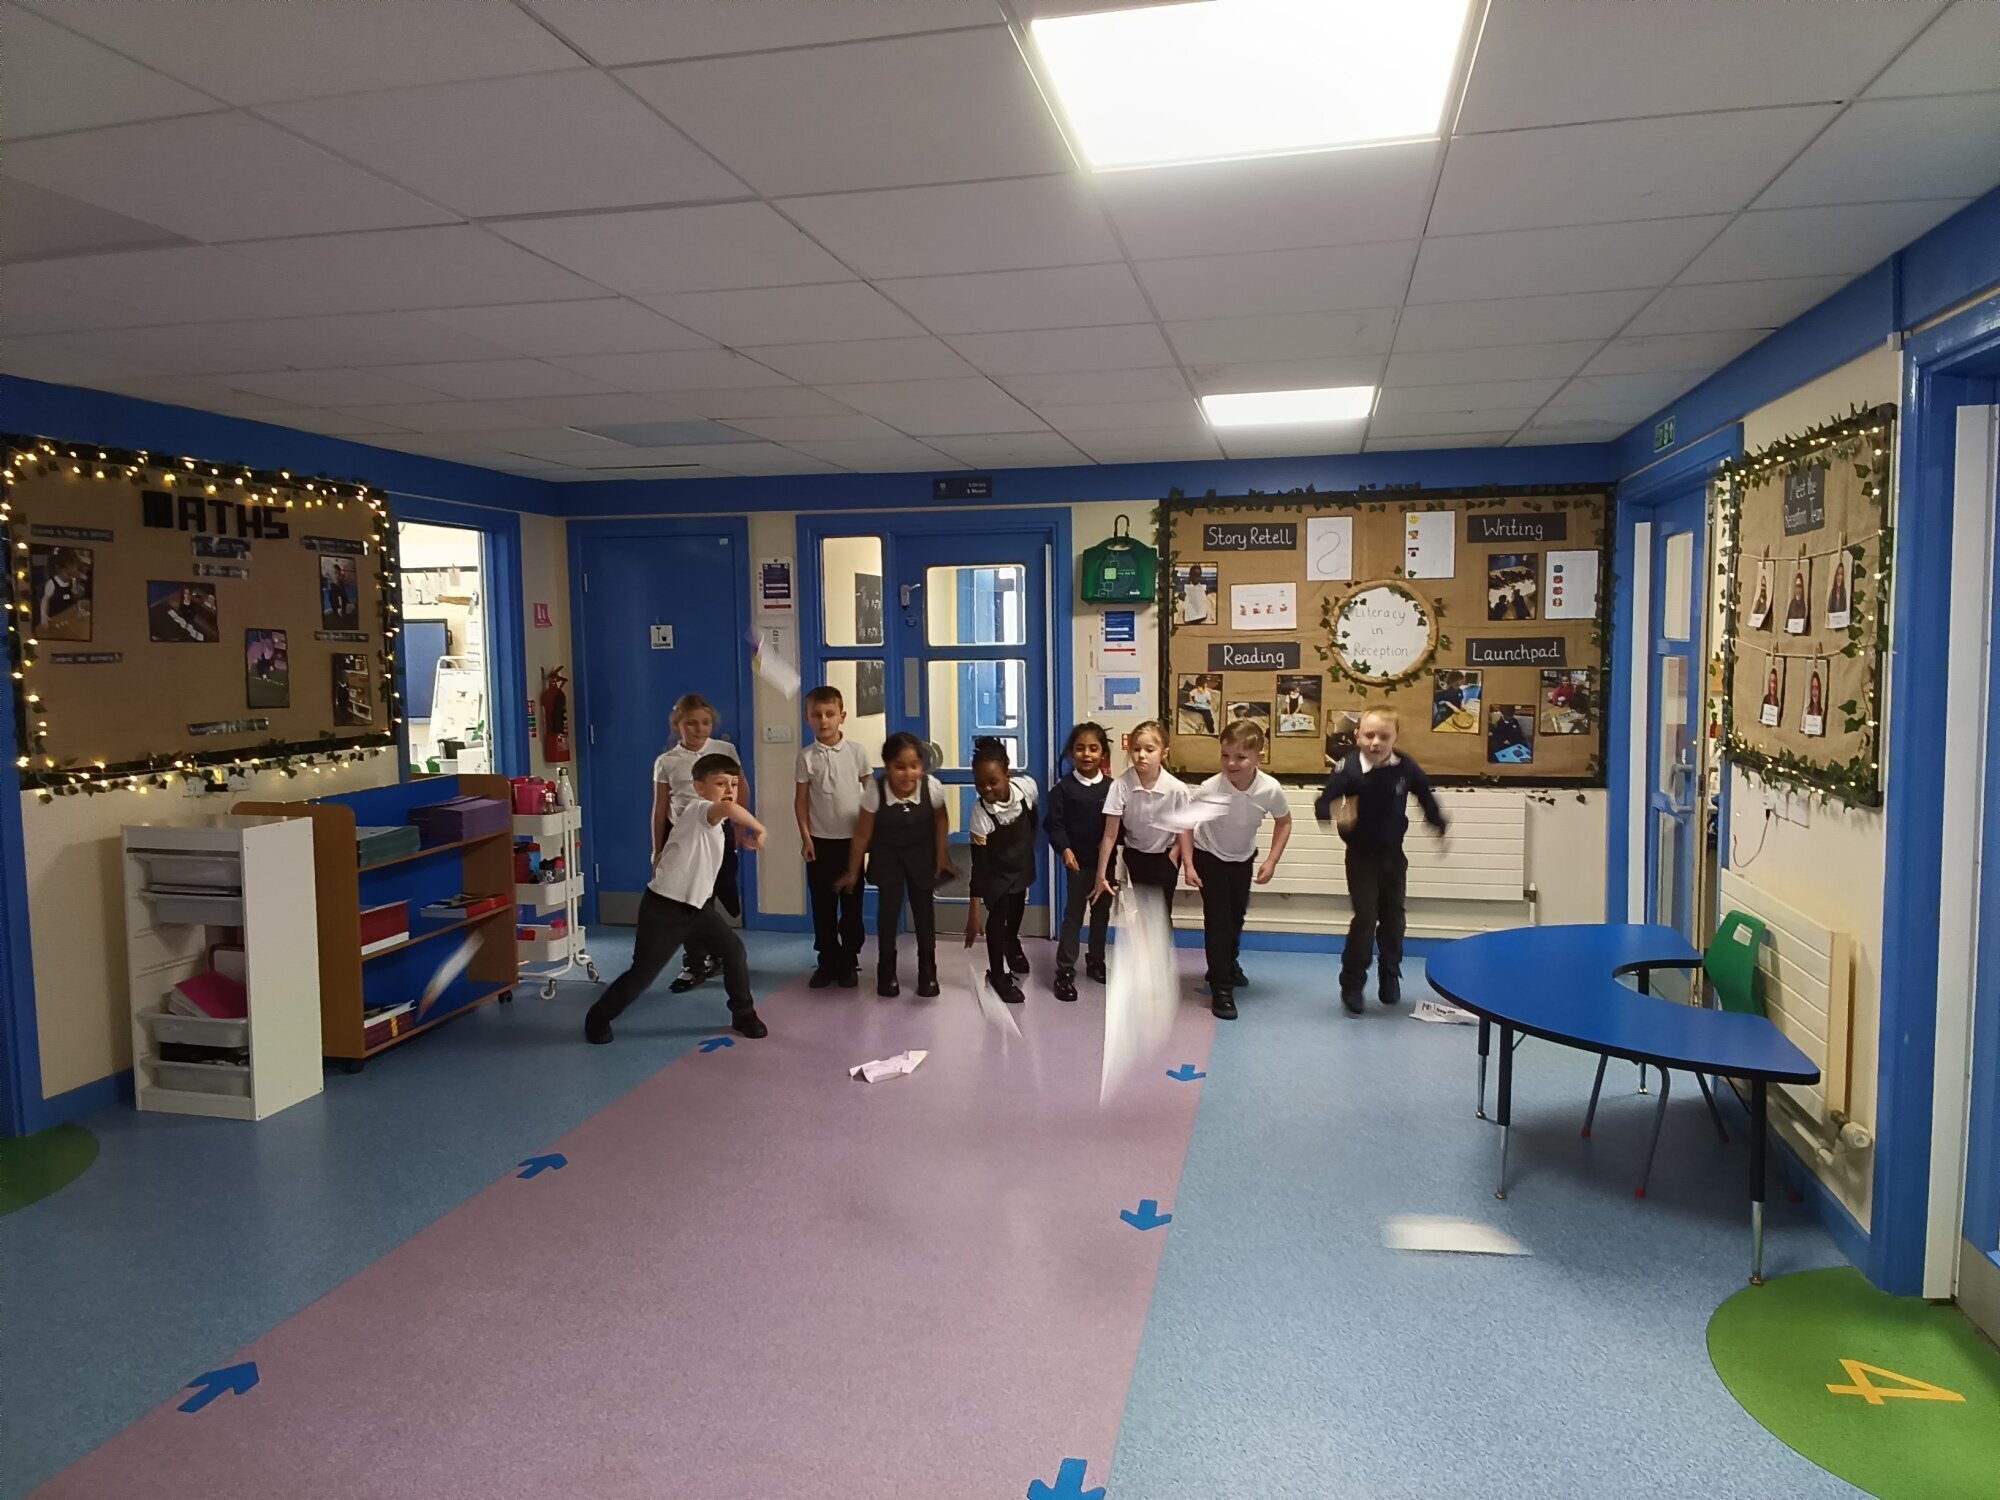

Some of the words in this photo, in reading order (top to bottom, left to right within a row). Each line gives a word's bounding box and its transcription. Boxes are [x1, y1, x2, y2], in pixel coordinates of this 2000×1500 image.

[1206, 526, 1247, 551] Story
[1250, 526, 1293, 545] Retell
[1482, 518, 1544, 541] Writing
[1355, 606, 1406, 627] Literacy
[1371, 627, 1384, 635] in
[1223, 644, 1285, 669] Reading
[1354, 641, 1409, 660] Reception
[1472, 641, 1561, 663] Launchpad
[1825, 1358, 1967, 1405] 4
